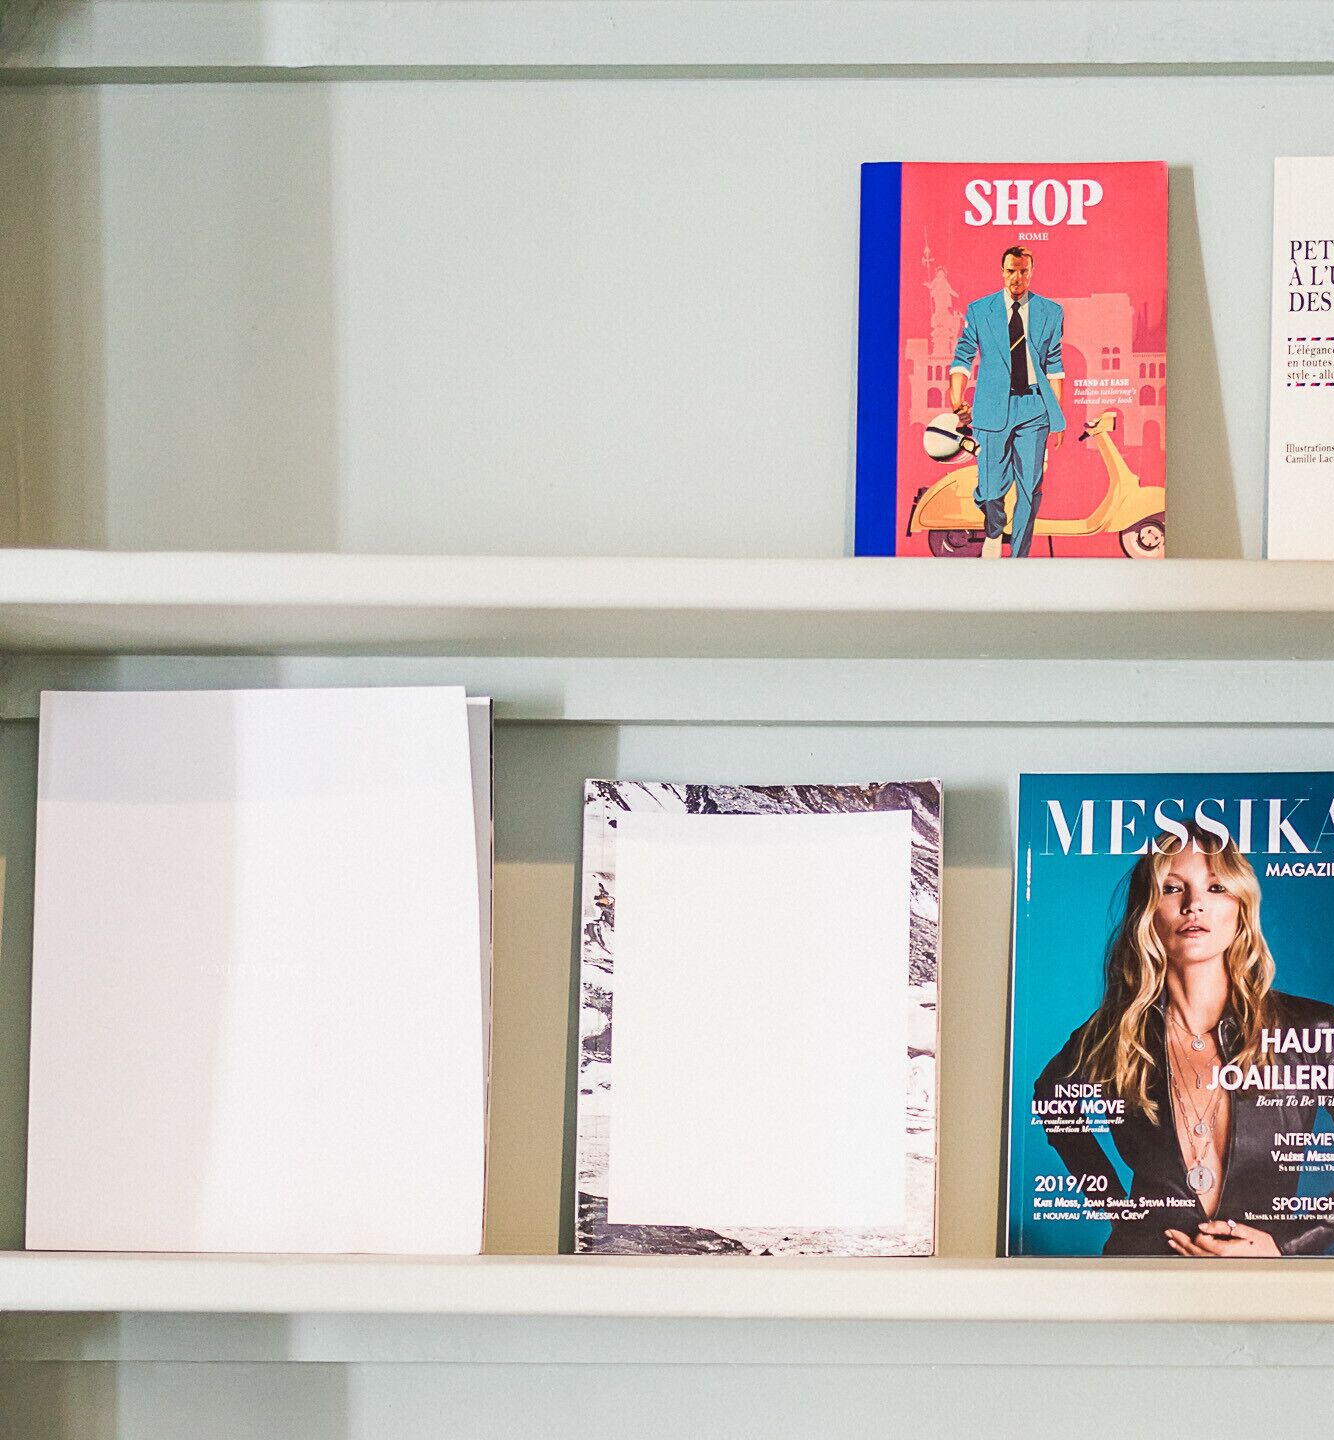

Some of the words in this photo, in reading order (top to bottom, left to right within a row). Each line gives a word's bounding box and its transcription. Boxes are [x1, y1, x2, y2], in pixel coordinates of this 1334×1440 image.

[964, 178, 1103, 227] SHOP
[1018, 232, 1049, 241] ROME
[1288, 260, 1304, 287] À
[1289, 291, 1332, 312] DES
[1302, 359, 1332, 367] toutes
[1287, 370, 1310, 380] style
[1074, 379, 1098, 387] STAND
[1099, 379, 1109, 387] AT
[1117, 396, 1133, 404] look
[1286, 443, 1334, 453] Illustrations
[1286, 454, 1317, 464] Camille
[1054, 1084, 1102, 1099] INSIDE
[1256, 1096, 1284, 1107] Born
[1286, 1096, 1299, 1107] To
[1300, 1096, 1314, 1107] Be
[1031, 1100, 1078, 1115] LUCKY
[1080, 1099, 1125, 1115] MOVE
[1034, 1174, 1108, 1194] 2019/20
